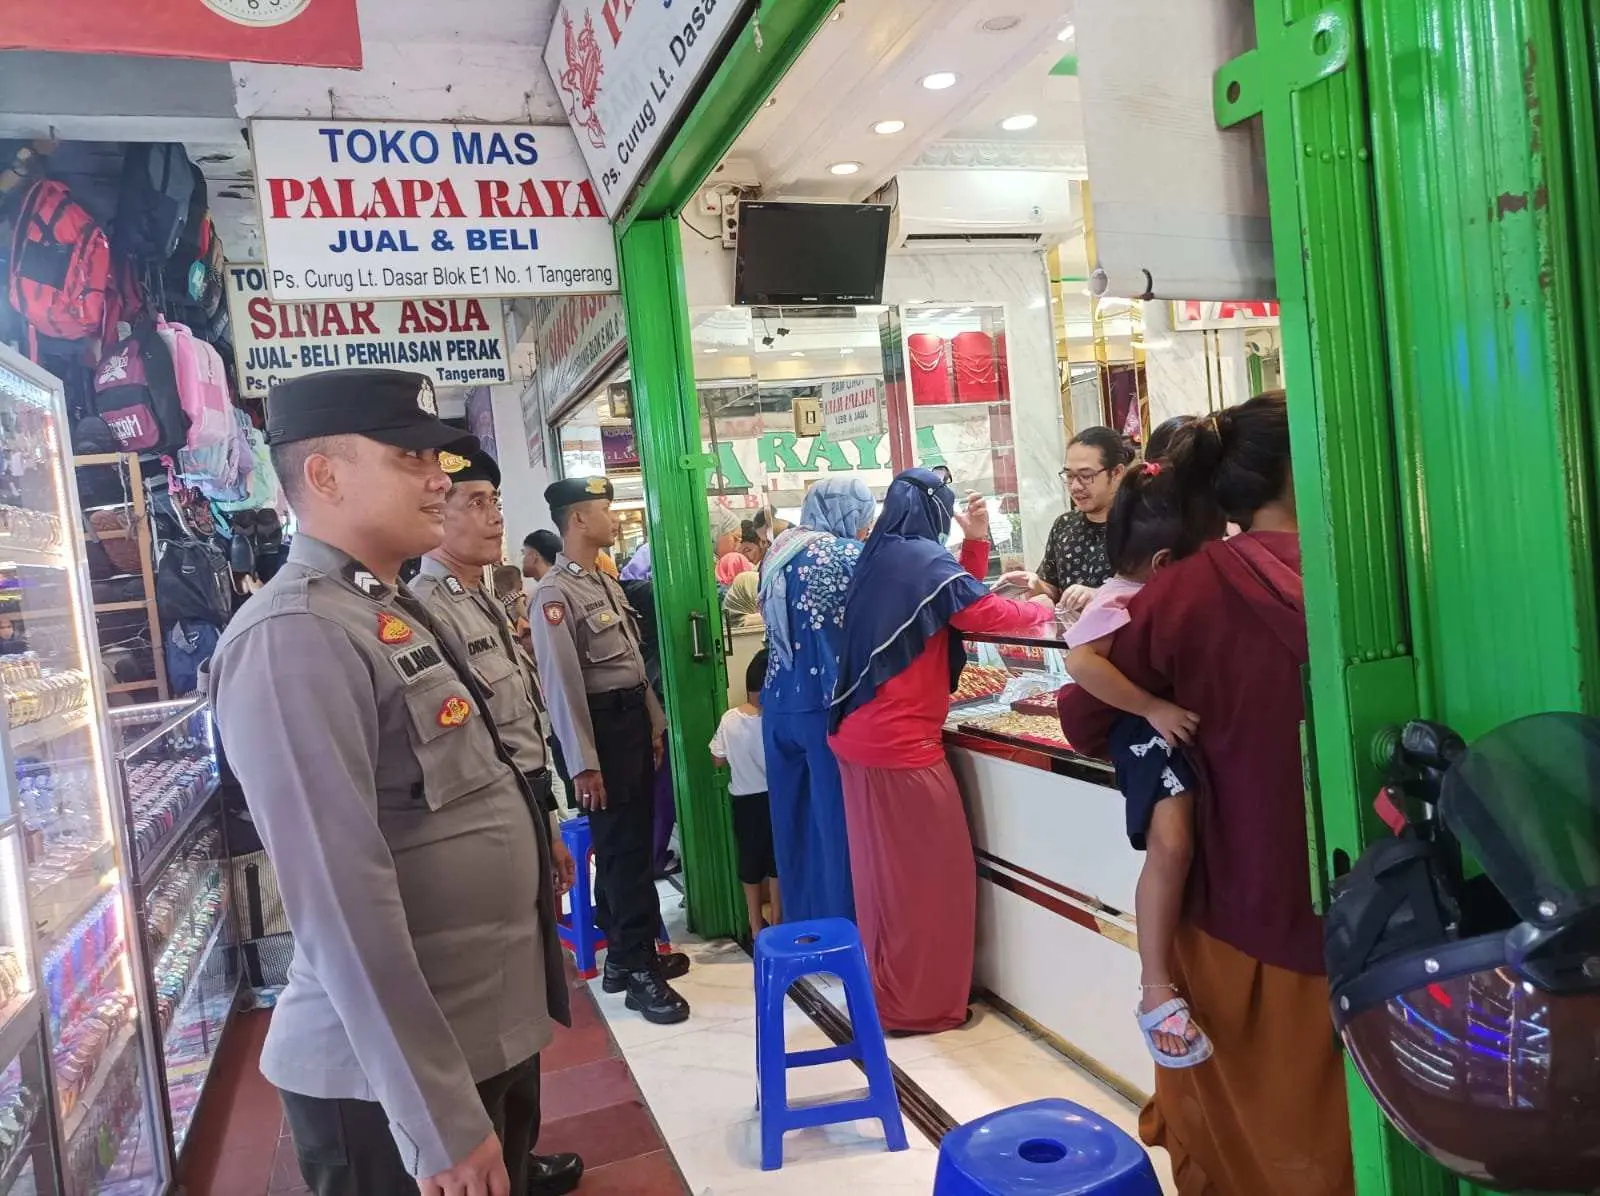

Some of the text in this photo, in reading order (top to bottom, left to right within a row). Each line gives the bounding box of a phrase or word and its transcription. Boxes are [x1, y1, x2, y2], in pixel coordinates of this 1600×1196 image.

[601, 170, 621, 196] Ps.
[617, 99, 656, 165] Curug
[650, 66, 674, 103] Lt.
[319, 128, 539, 166] TOKO MAS
[266, 176, 605, 221] PALAPA RAYA
[328, 228, 539, 253] JUAL & BELI
[231, 268, 267, 291] TO
[273, 264, 613, 292] Ps. Curug Lt. Dasar Blok E1 No. 1 Tangerang
[248, 297, 490, 340] SINAR ASIA
[346, 340, 443, 365] PERHIASAN
[447, 339, 502, 360] PERAK
[436, 367, 506, 383] Tangerang
